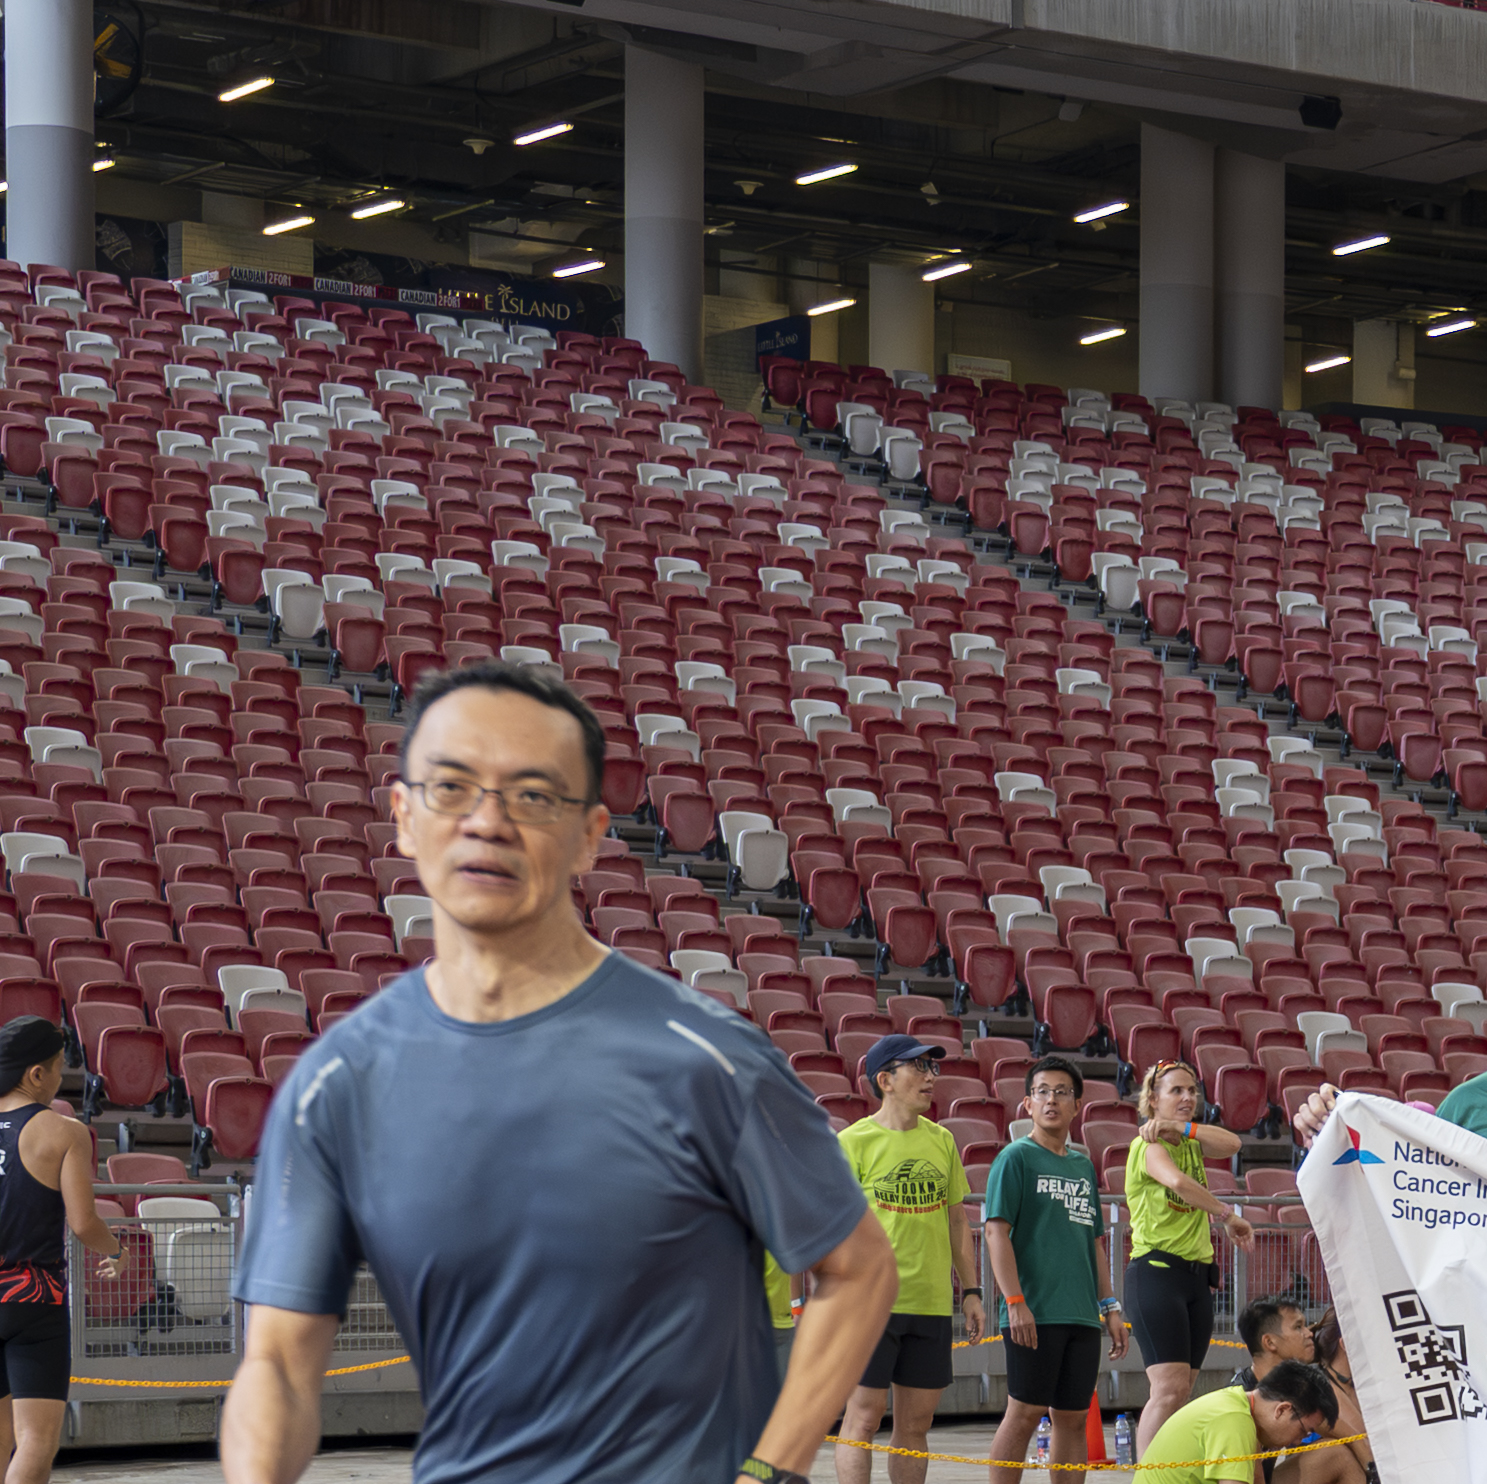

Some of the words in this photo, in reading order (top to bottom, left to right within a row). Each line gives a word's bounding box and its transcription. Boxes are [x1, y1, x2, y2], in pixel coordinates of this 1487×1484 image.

[230, 266, 266, 283] CANADIAN
[268, 273, 291, 287] 2FOR1
[315, 278, 352, 296] CANADIAN
[354, 283, 377, 298] 2FOR1
[401, 289, 436, 306] CANADIAN
[438, 294, 461, 308] 2FOR1
[1036, 1178, 1080, 1197] RELAY
[1393, 1170, 1471, 1197] Cancer
[902, 1195, 917, 1205] FOR
[1064, 1194, 1089, 1212] LIFE
